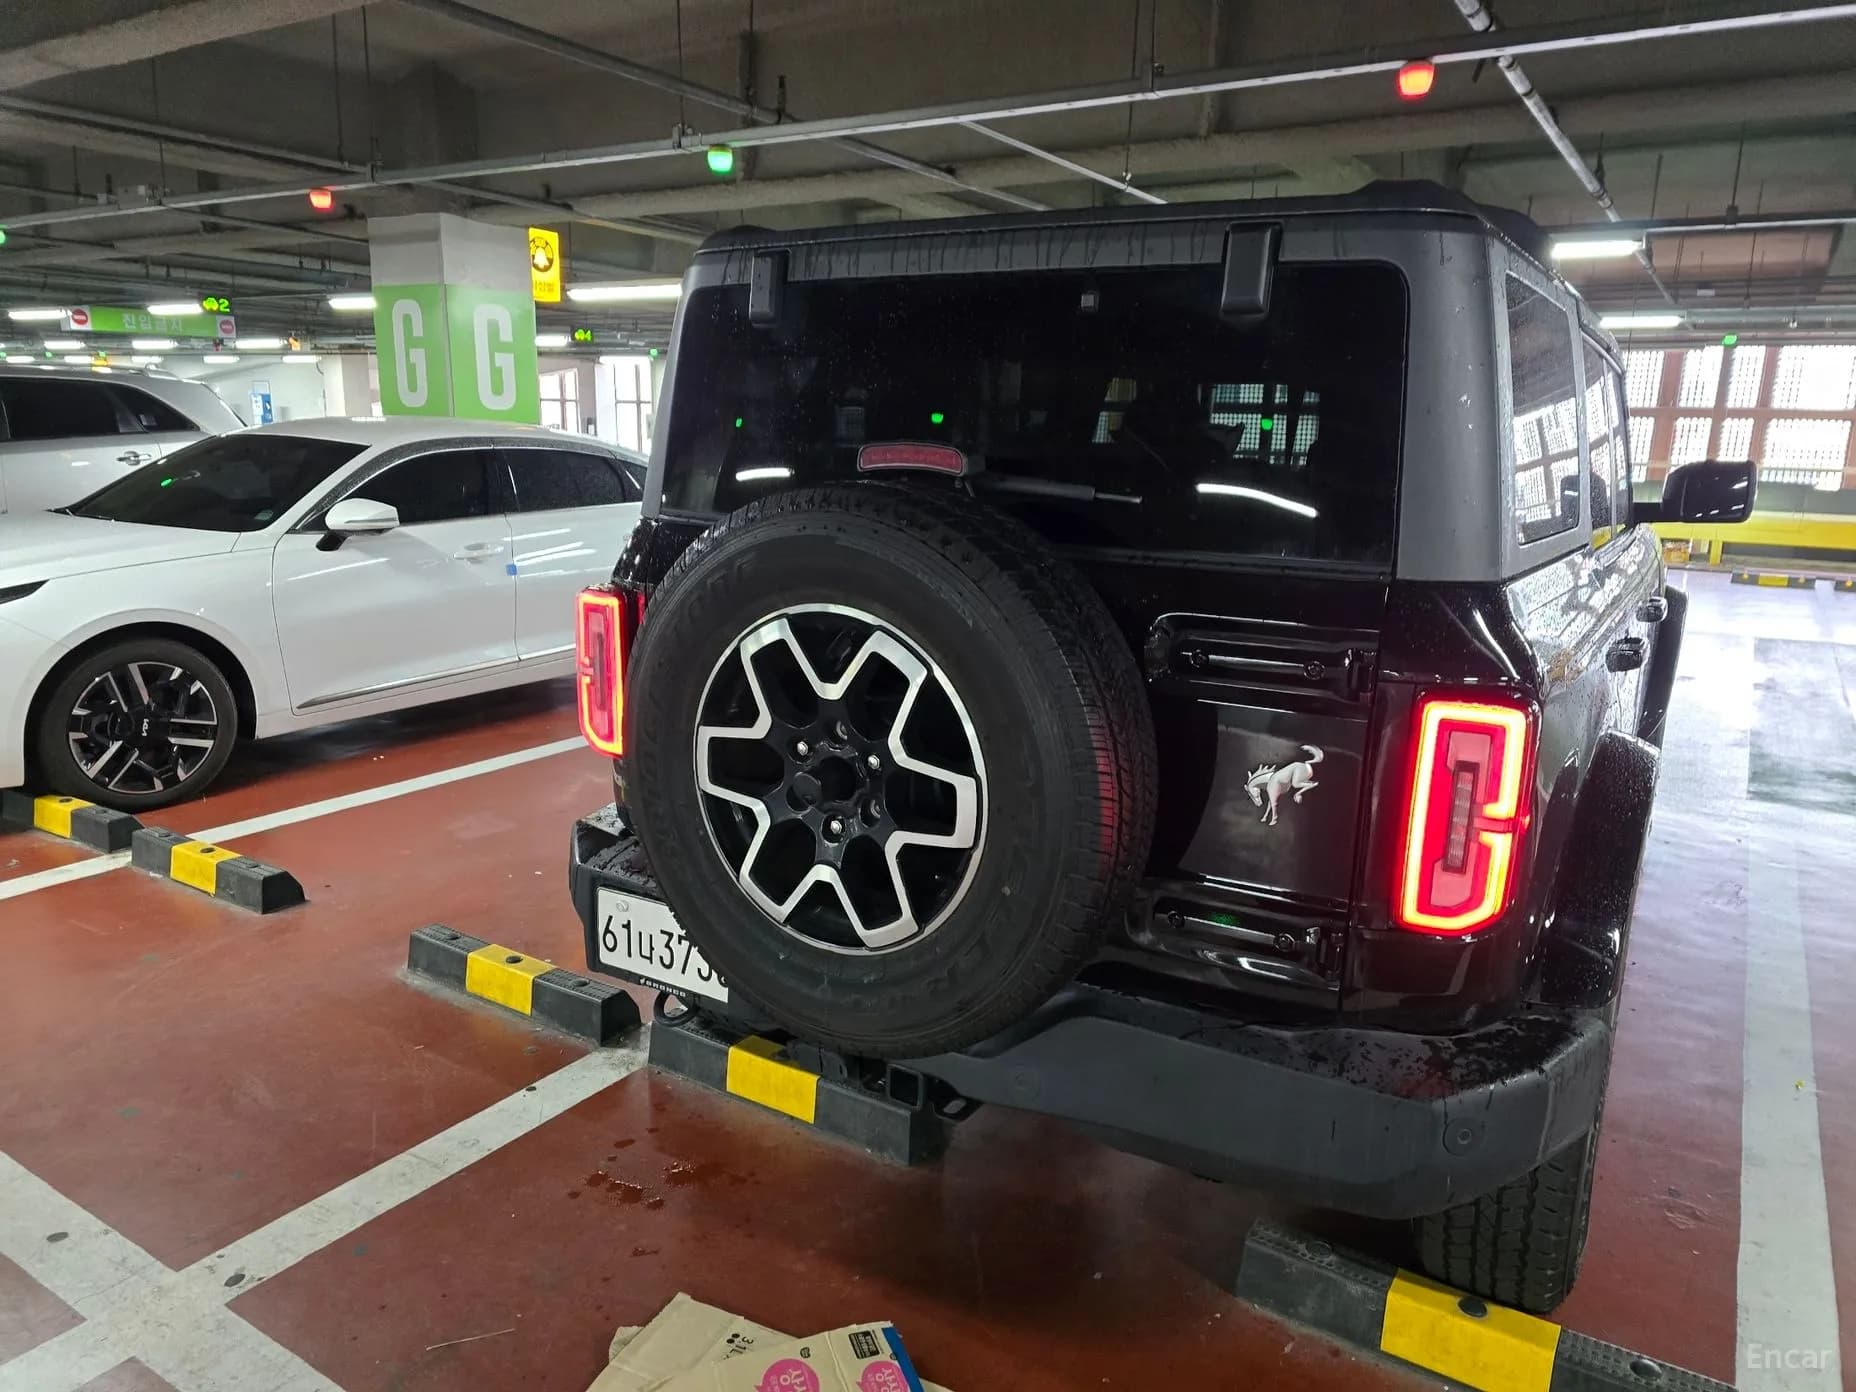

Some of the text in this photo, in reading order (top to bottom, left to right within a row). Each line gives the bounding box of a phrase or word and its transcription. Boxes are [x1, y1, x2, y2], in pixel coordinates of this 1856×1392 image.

[219, 298, 231, 313] 2
[392, 298, 428, 408] G
[473, 303, 517, 411] G
[602, 914, 729, 989] 61나37
